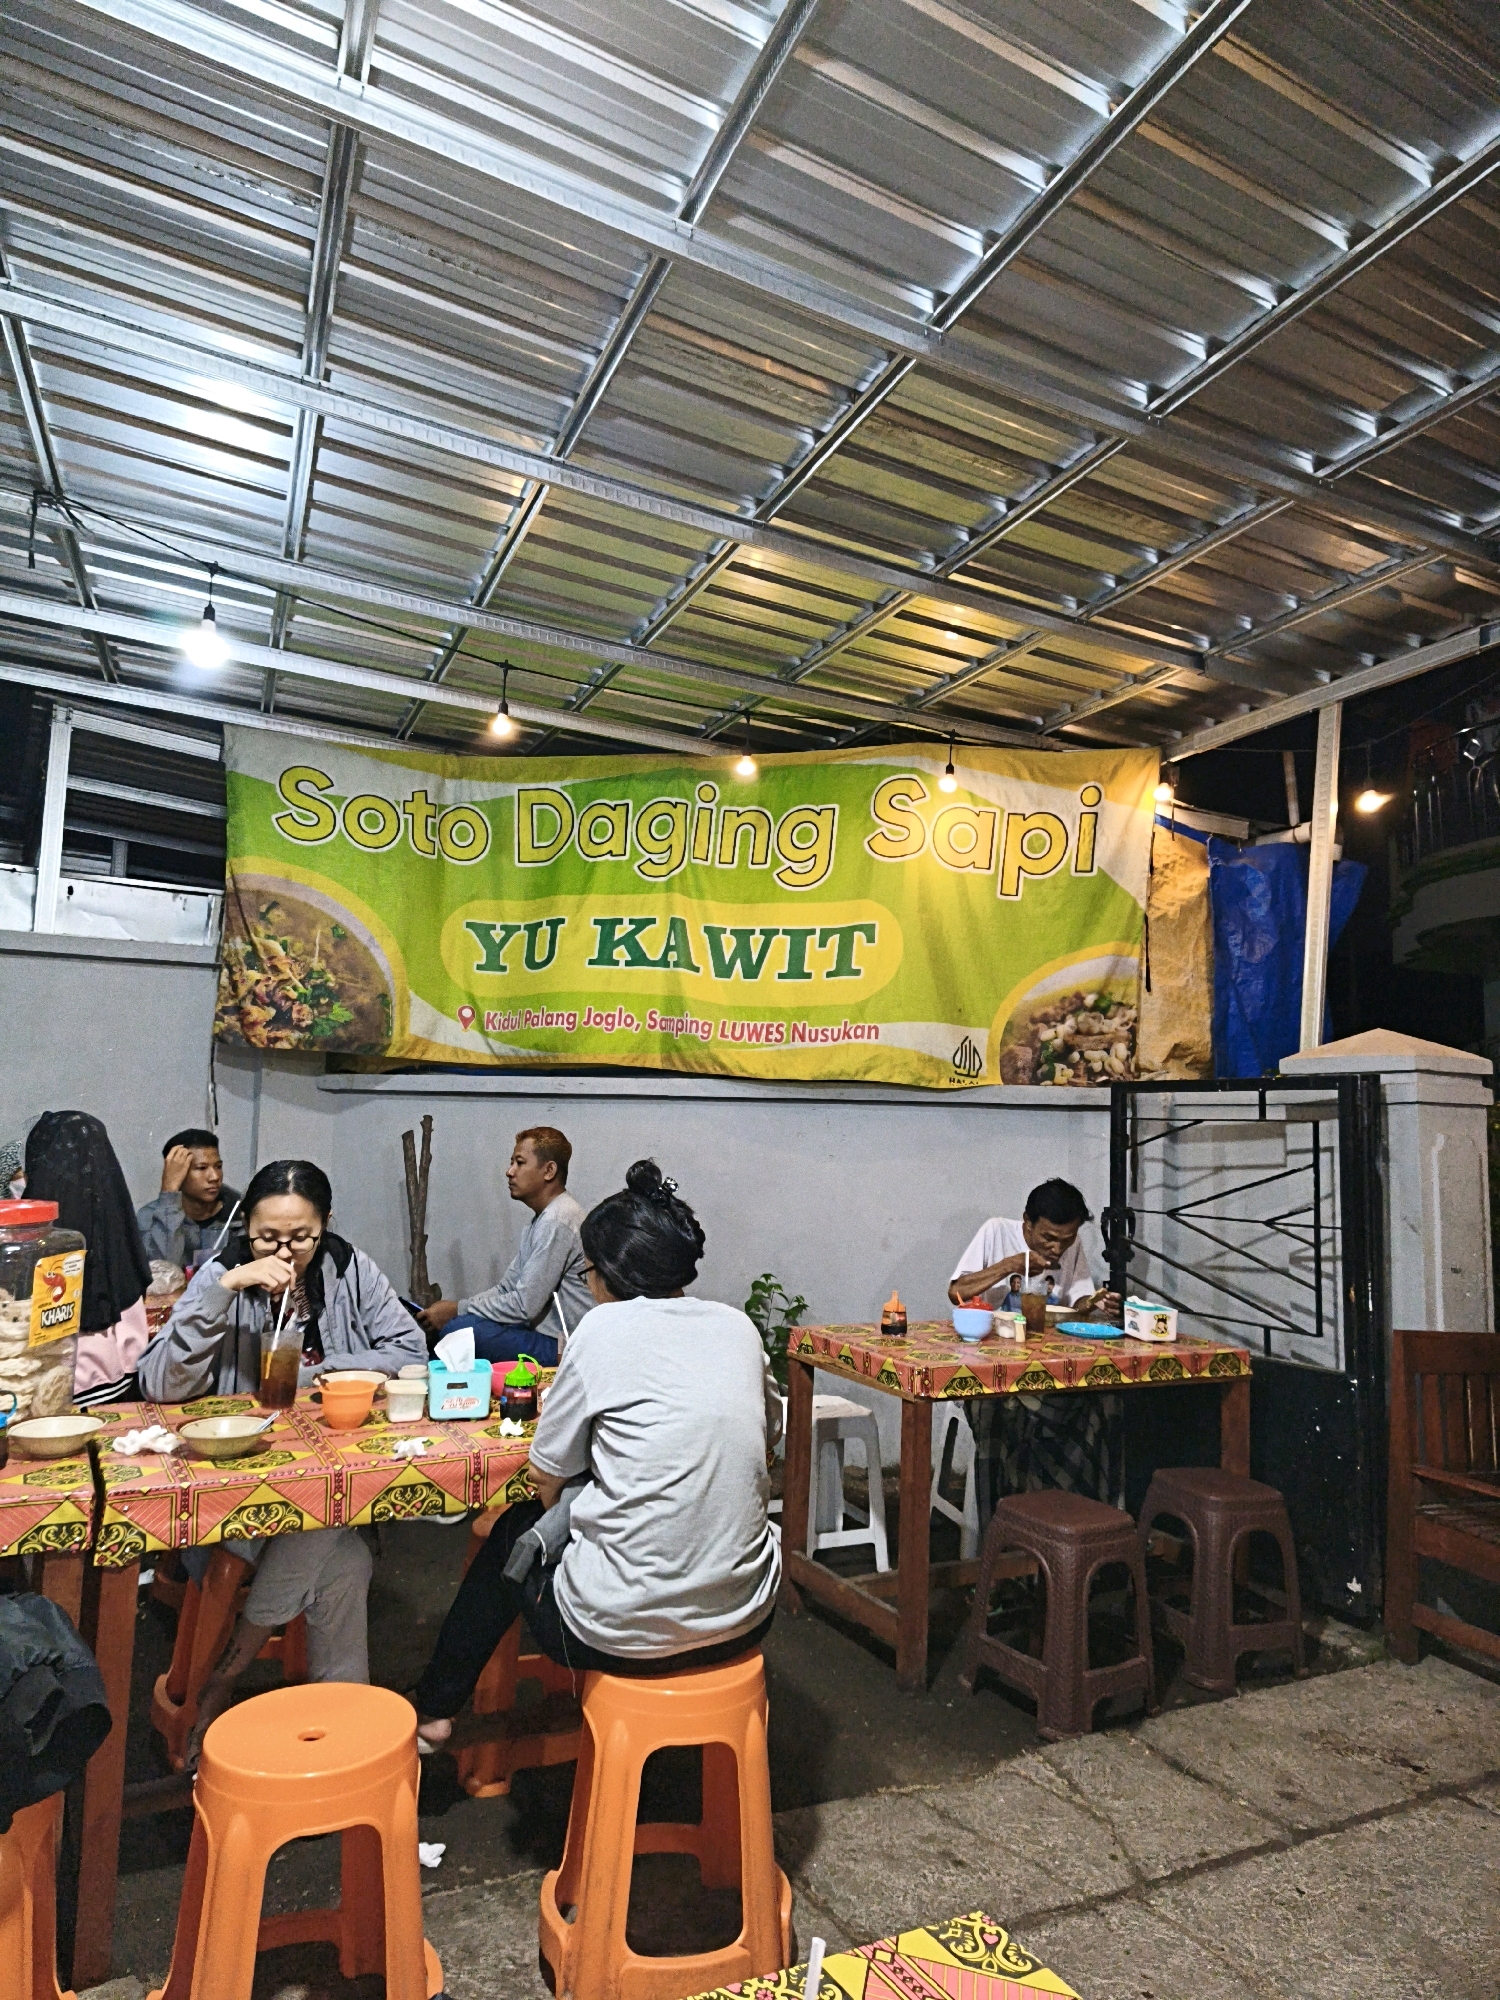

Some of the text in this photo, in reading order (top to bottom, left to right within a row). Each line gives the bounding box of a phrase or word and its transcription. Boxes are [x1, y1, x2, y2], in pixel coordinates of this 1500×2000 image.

[272, 764, 1103, 900] Soto Daging Sapi
[464, 915, 877, 982] YU KAWIT
[484, 1006, 880, 1043] Kidul Palang Joglo, Samping LUWES Nusukan
[41, 1301, 75, 1329] KHARIS
